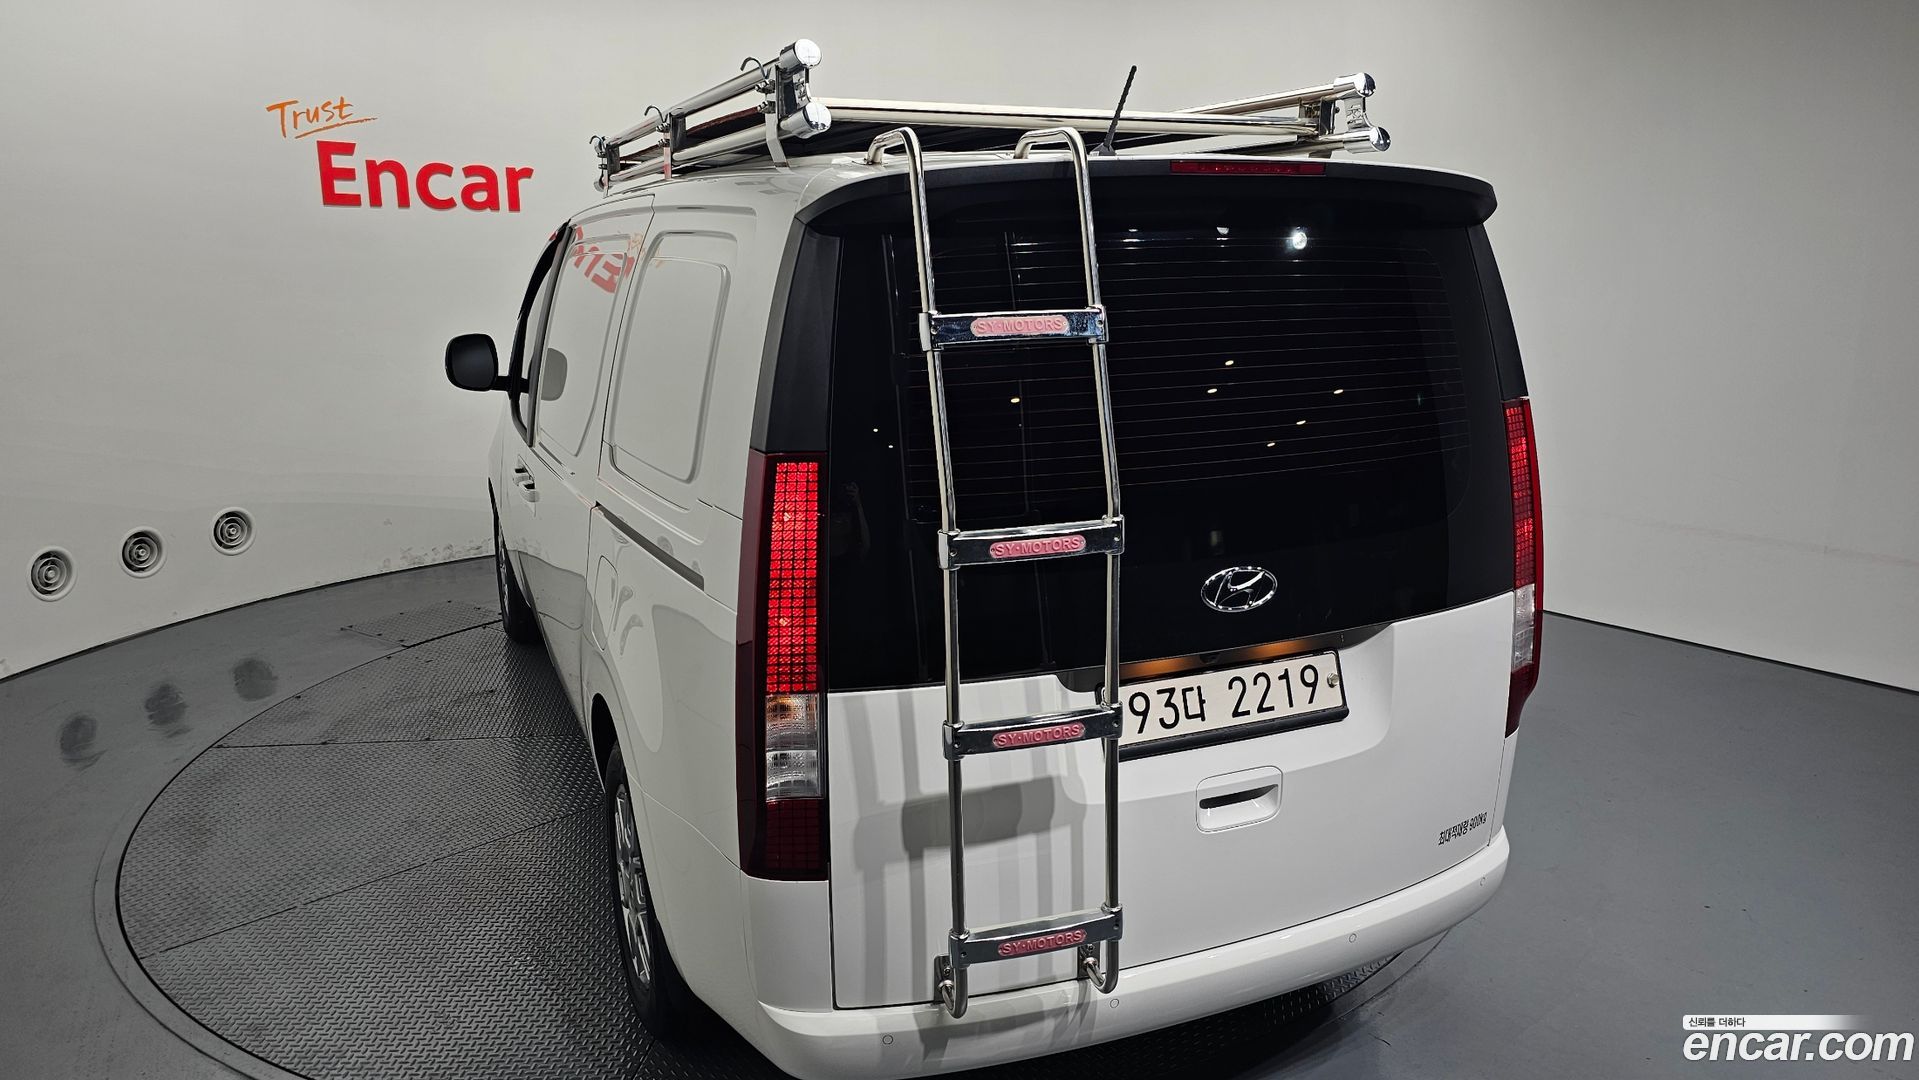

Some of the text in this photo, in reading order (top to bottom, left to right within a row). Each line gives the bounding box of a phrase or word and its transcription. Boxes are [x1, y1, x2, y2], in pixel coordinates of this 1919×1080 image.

[266, 96, 354, 139] Trust
[316, 140, 534, 213] Encar
[1128, 664, 1320, 734] 93다 2219
